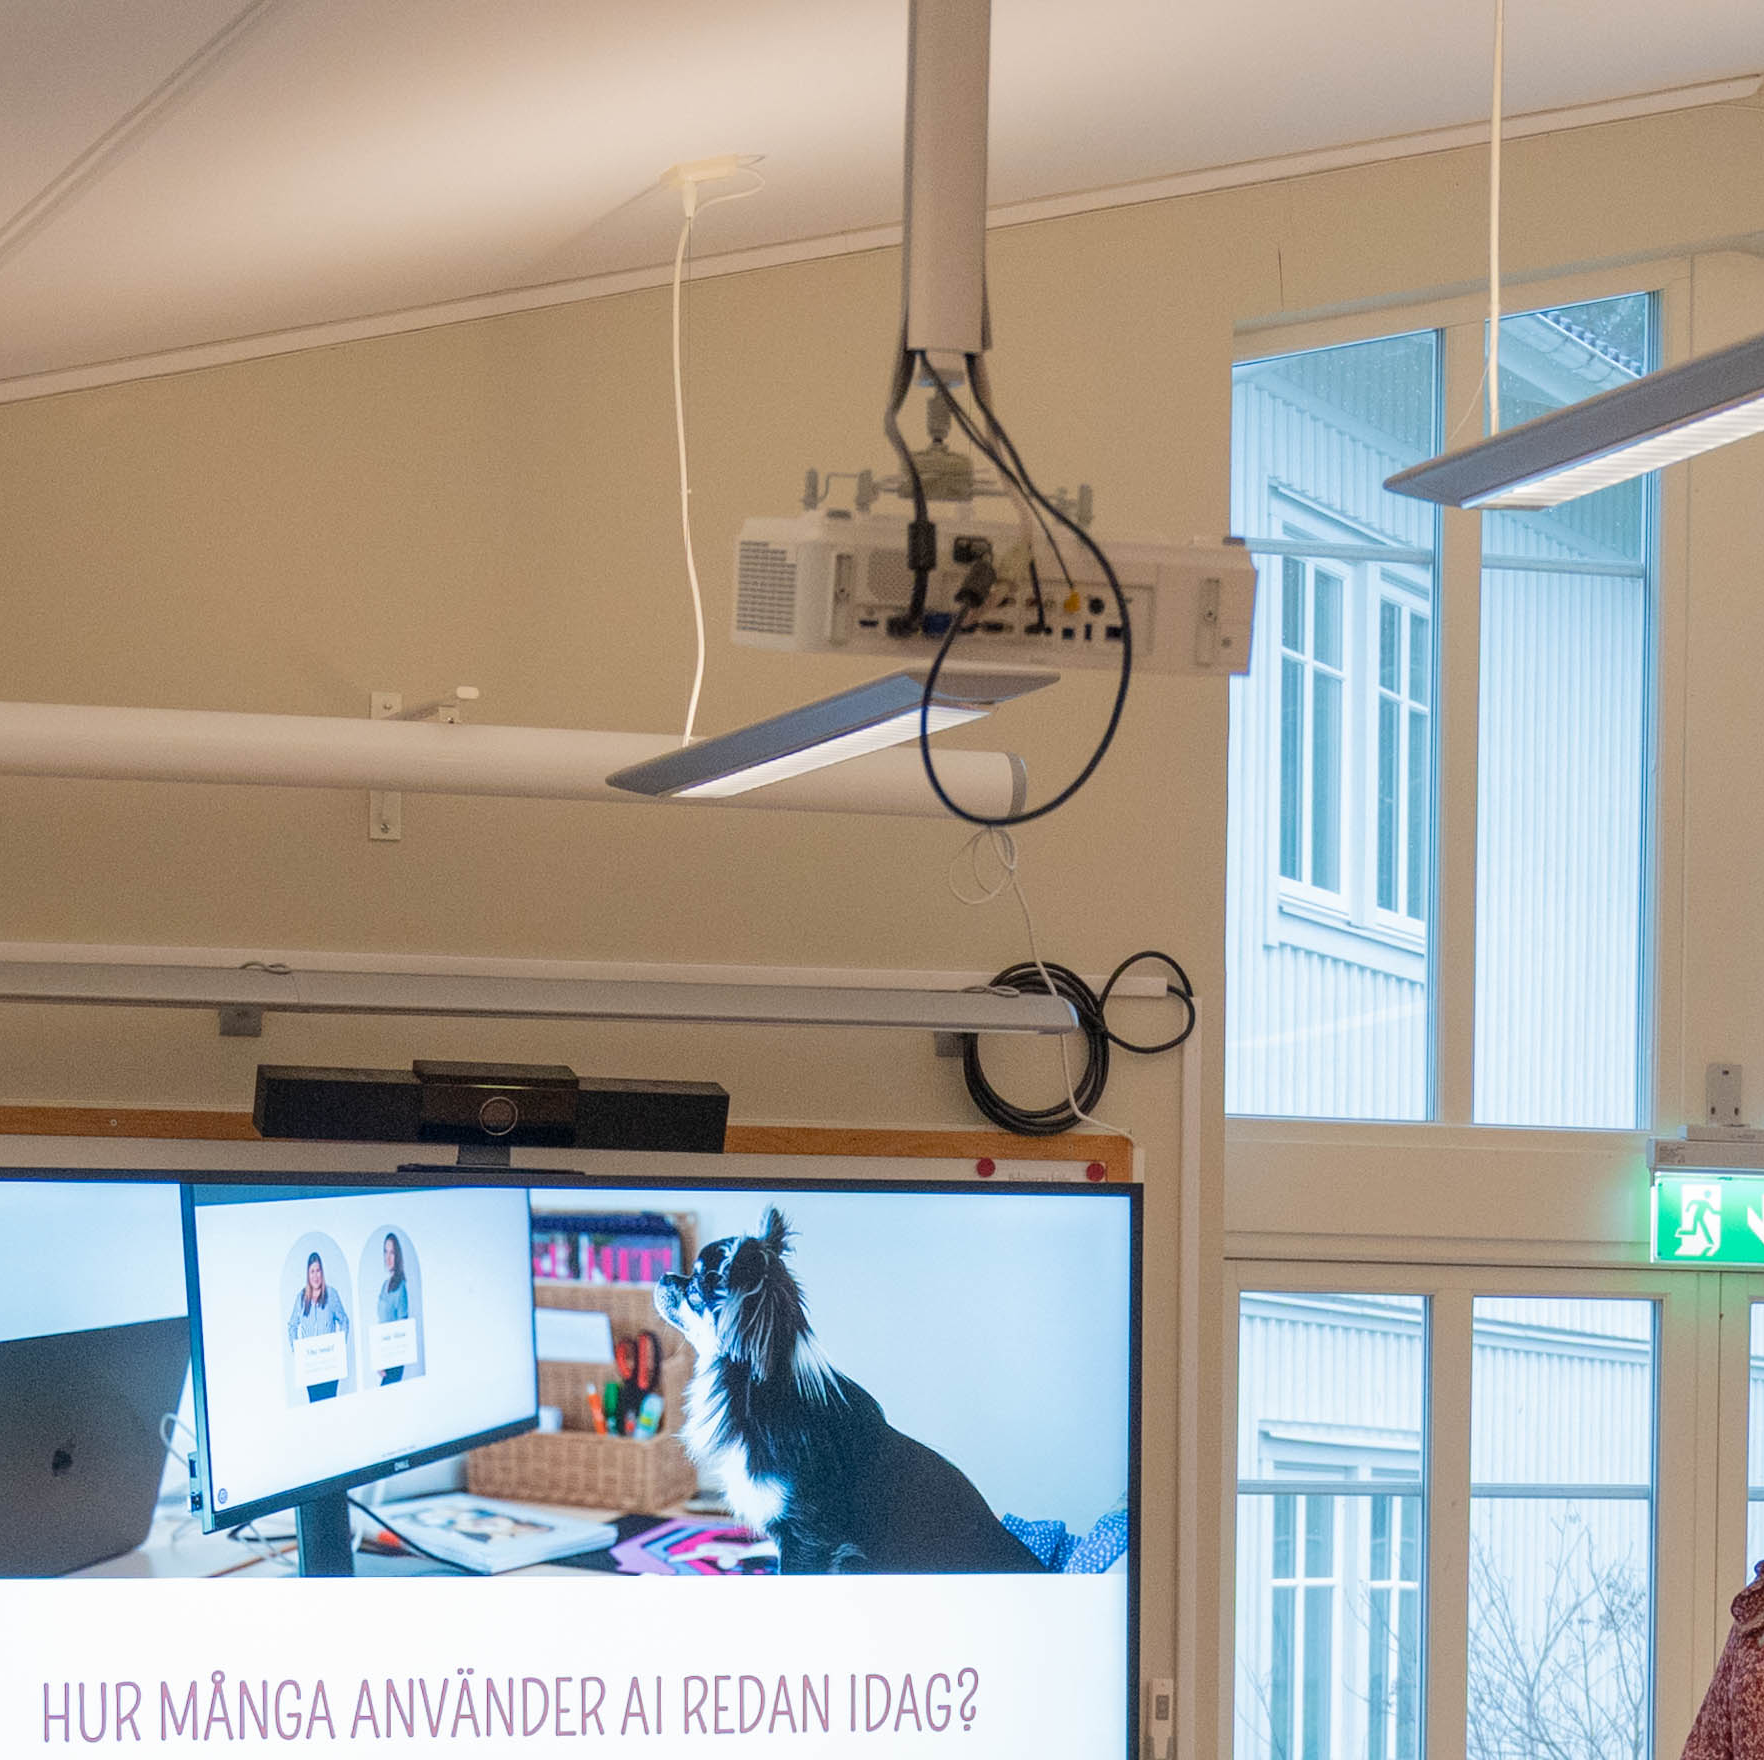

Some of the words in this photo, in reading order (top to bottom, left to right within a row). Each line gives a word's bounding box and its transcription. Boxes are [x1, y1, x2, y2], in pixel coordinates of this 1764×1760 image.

[44, 1681, 142, 1742] HUR
[161, 1670, 335, 1741] MÅNGA
[350, 1668, 605, 1739] ANVÄNDER
[621, 1676, 662, 1736] AI
[684, 1674, 829, 1734] REDAN
[851, 1667, 979, 1732] IDAG?
